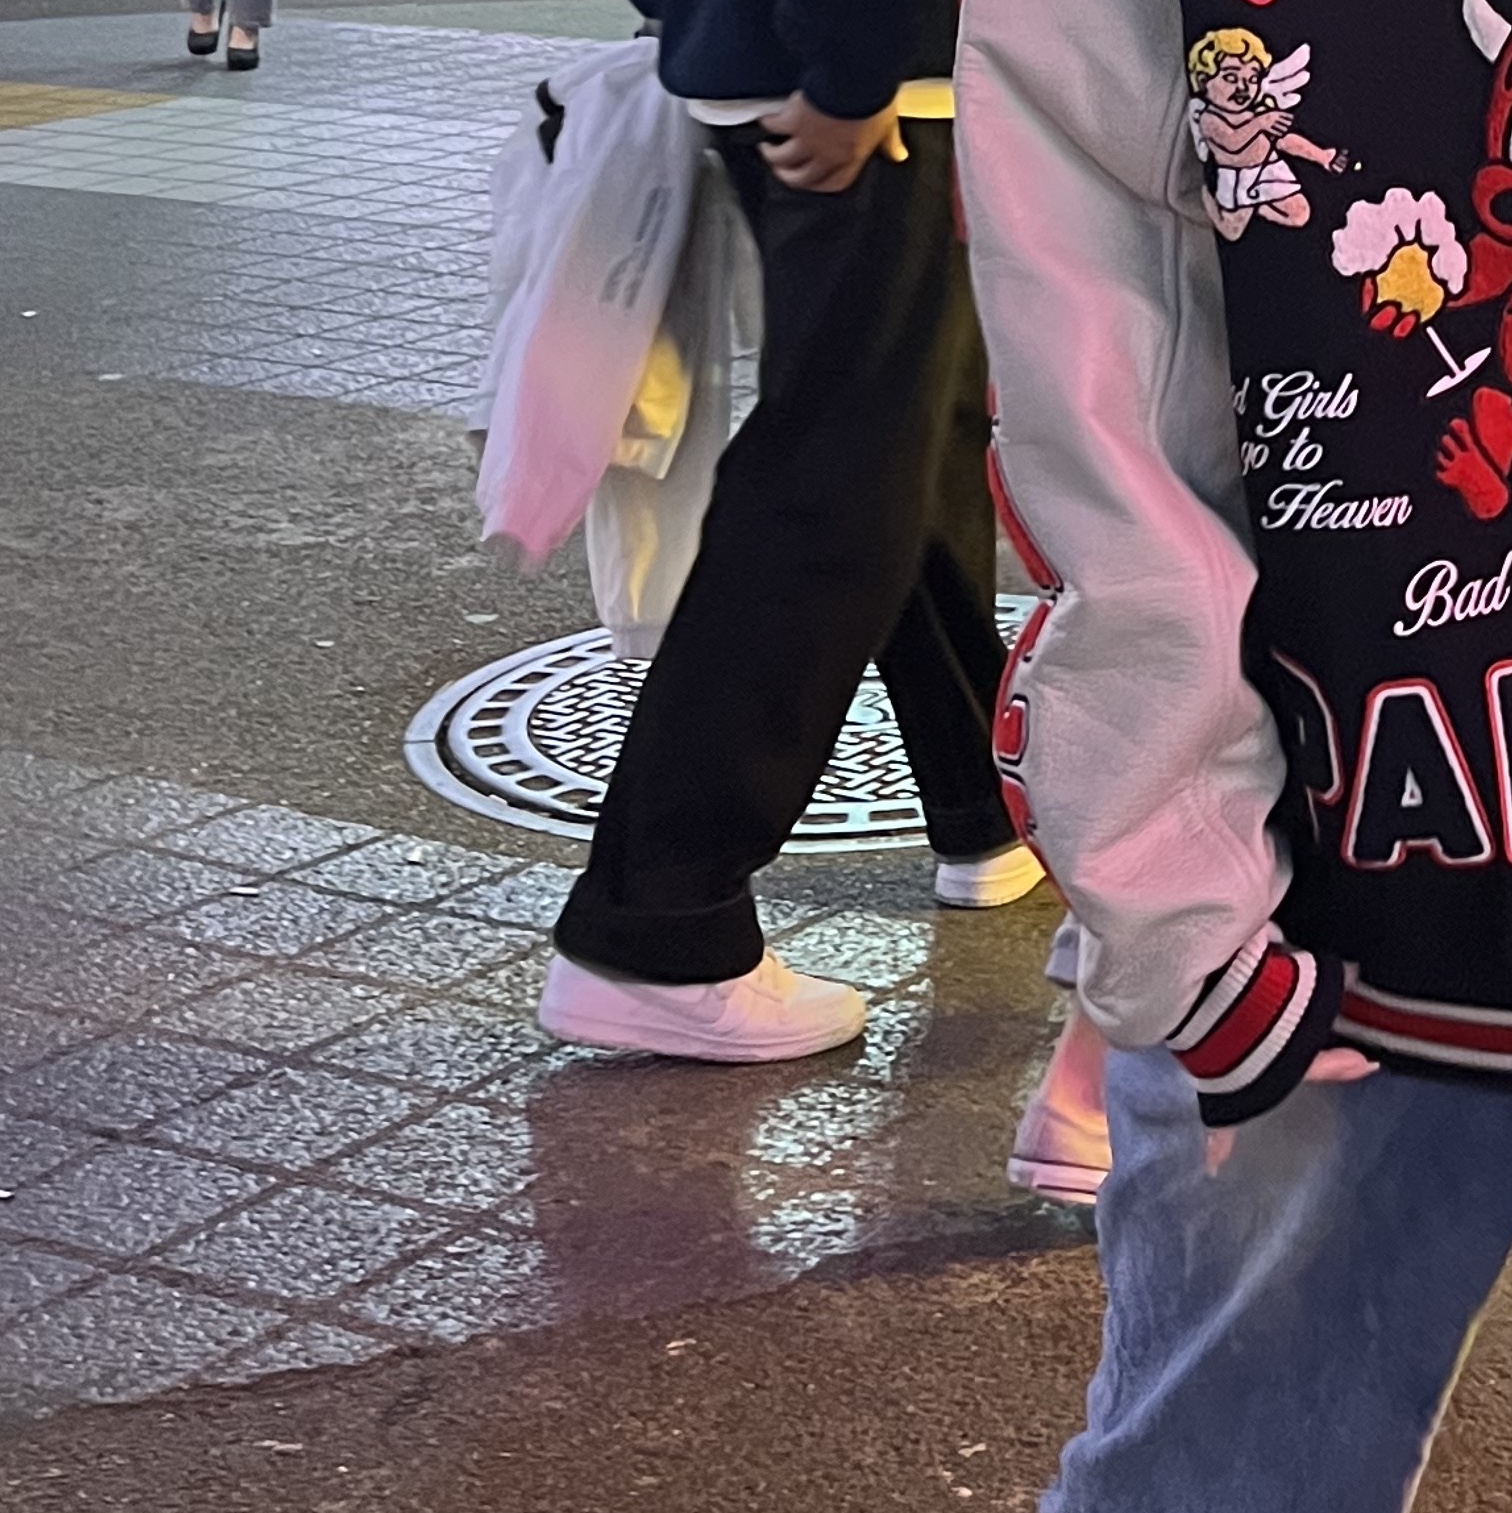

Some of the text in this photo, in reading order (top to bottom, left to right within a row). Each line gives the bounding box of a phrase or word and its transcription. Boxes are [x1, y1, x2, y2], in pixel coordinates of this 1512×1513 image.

[1256, 371, 1359, 437] Girls
[1283, 426, 1324, 472] to
[1261, 479, 1413, 531] Heaven
[1393, 551, 1512, 637] Bad
